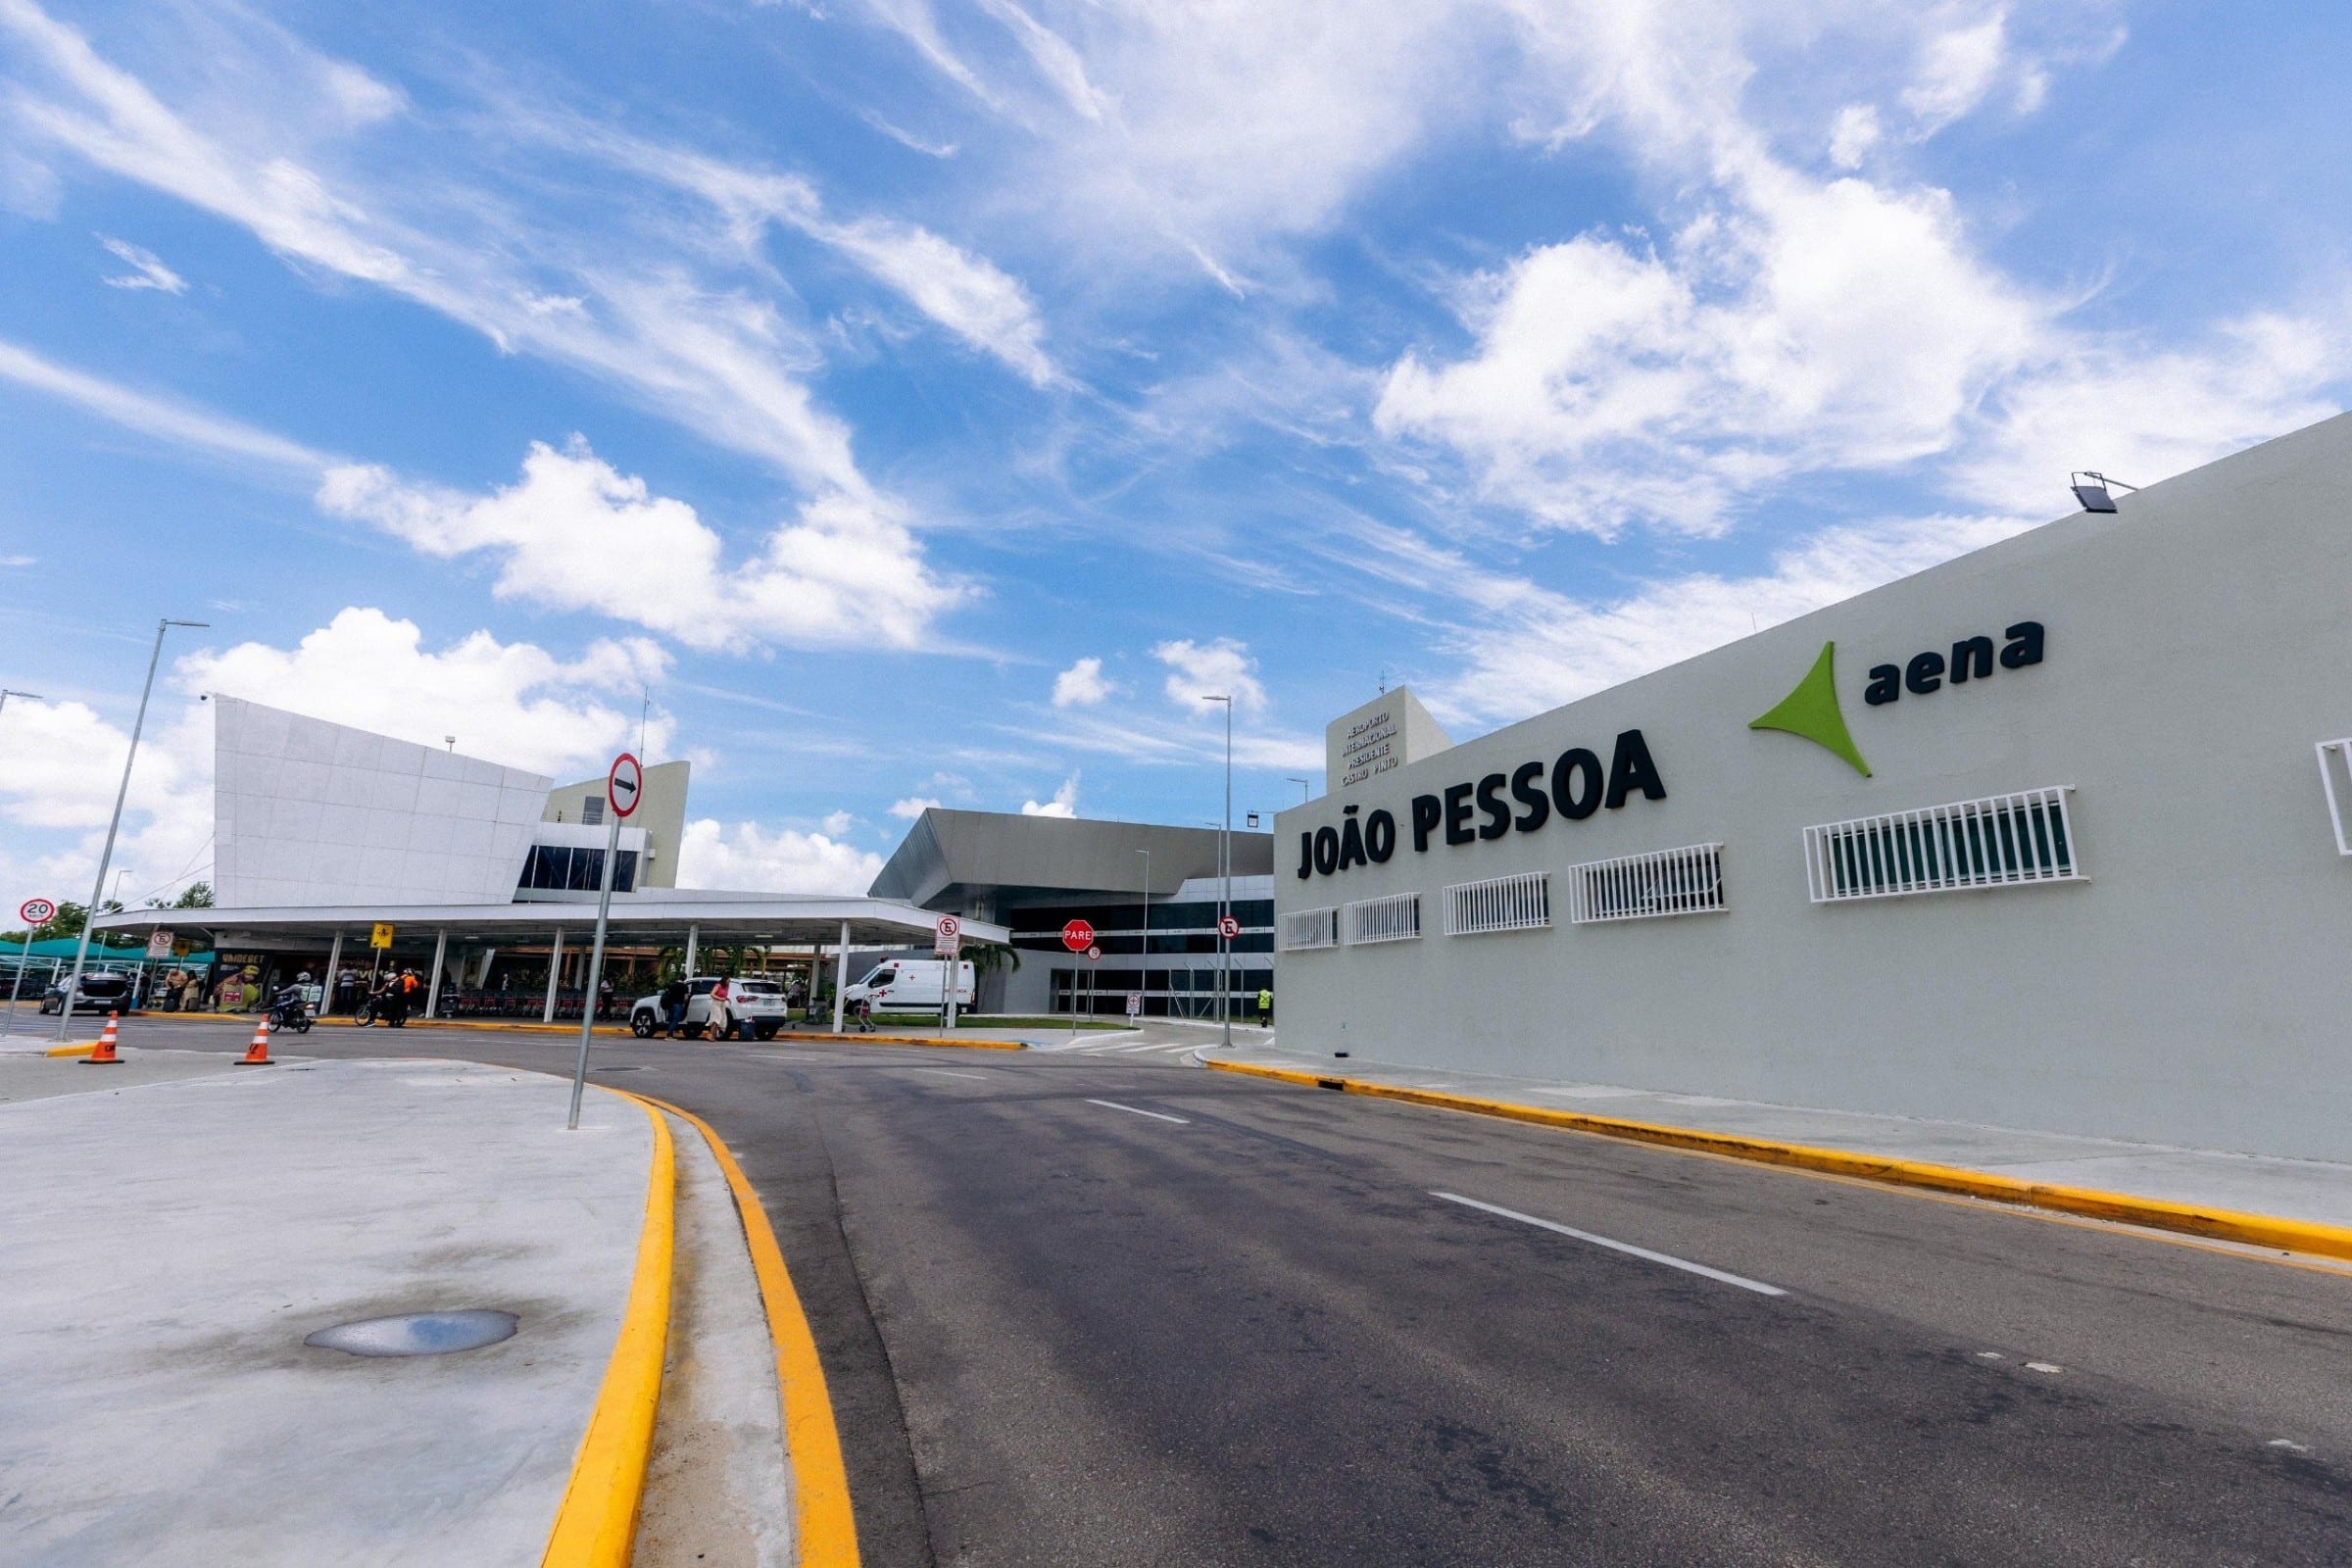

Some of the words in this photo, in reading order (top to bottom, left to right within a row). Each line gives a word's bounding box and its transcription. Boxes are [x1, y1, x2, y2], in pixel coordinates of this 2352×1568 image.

[1864, 621, 2045, 707] aena
[1348, 711, 1390, 739] AEROPORTO
[1341, 724, 1397, 758] INTERNACIONAL
[1348, 744, 1390, 769] PRESIDENTE
[1342, 768, 1369, 787] CASTRO
[1374, 757, 1398, 774] PINTO
[1298, 805, 1396, 880] JOÃO
[1412, 729, 1667, 855] PESSOA
[27, 904, 48, 914] 20
[1064, 930, 1092, 941] PARE
